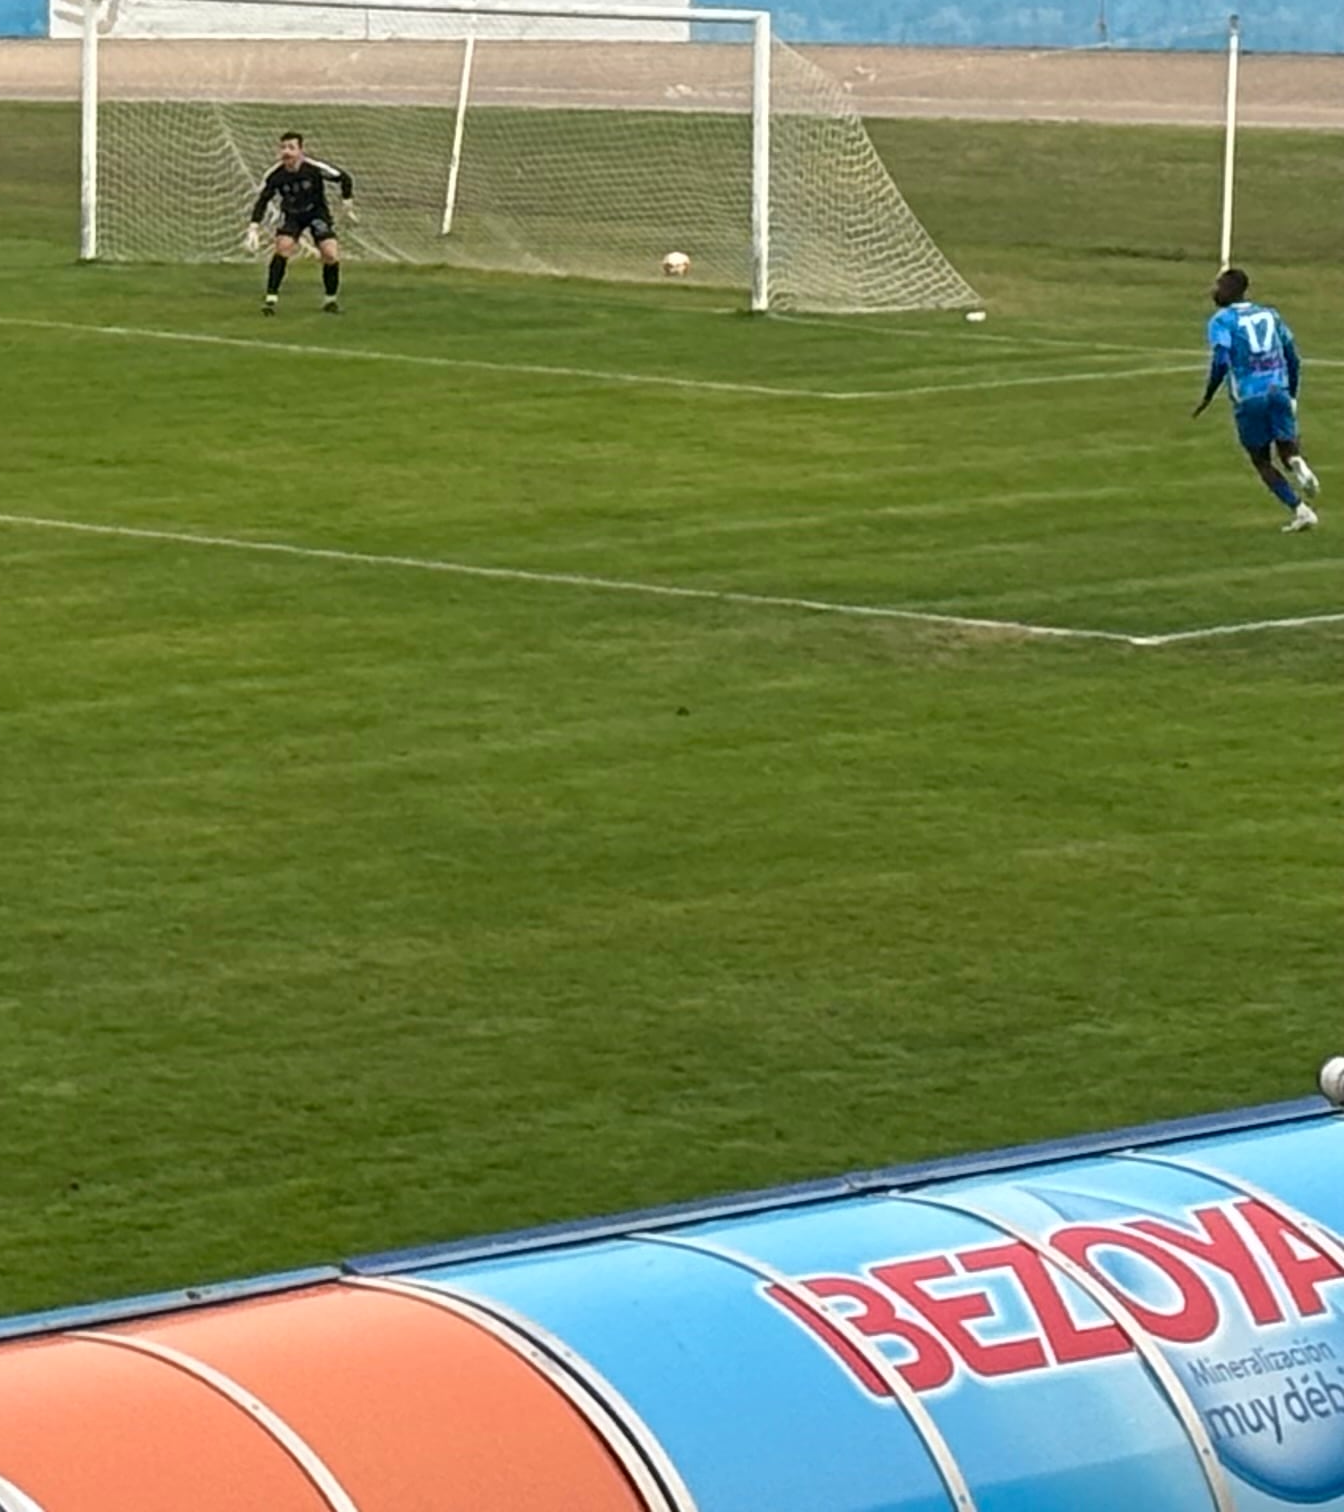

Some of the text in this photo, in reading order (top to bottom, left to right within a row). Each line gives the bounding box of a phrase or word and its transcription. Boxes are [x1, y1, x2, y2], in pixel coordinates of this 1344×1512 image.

[1238, 312, 1275, 354] 17
[764, 1199, 1344, 1398] BEZOYA
[1187, 1338, 1336, 1386] Mineralización
[1204, 1368, 1344, 1445] muy déb
